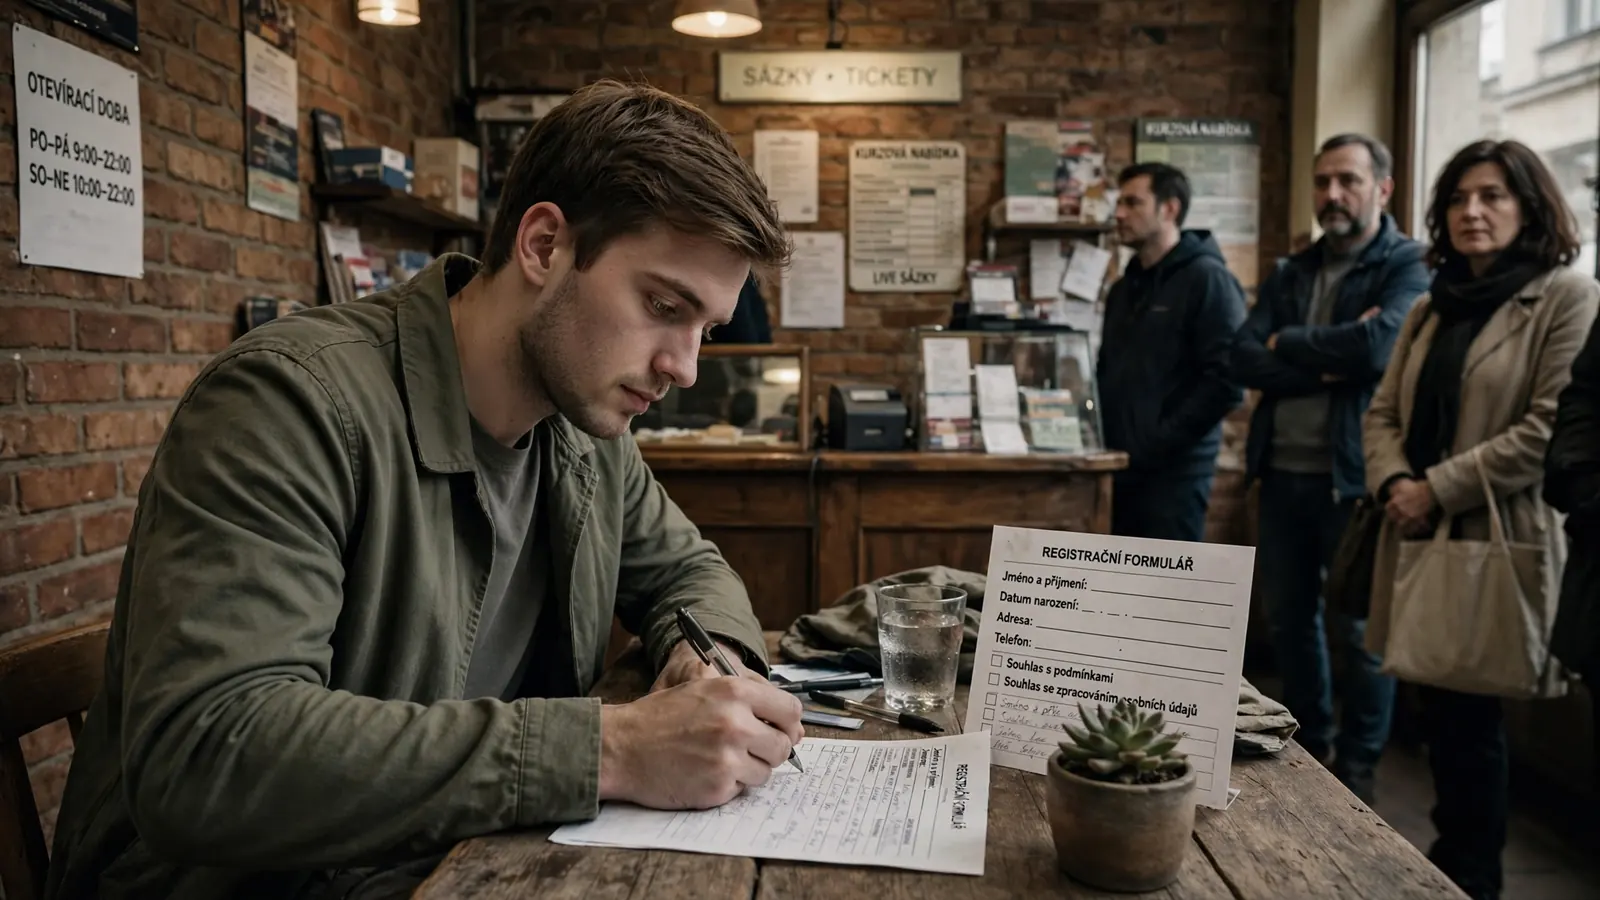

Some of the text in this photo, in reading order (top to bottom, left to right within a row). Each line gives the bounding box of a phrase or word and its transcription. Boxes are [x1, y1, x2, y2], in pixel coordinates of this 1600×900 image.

[742, 64, 938, 87] SÁZKY TICKETY
[28, 71, 130, 125] OTEVÍRACÍ DOBA
[873, 271, 896, 284] LIVE
[1042, 546, 1194, 571] REGISTRAČNÍ FORMULÁŘ
[1002, 571, 1034, 584] Jméno
[1000, 591, 1079, 610] Datum narození:
[996, 612, 1033, 626] Adresa:
[995, 632, 1032, 647] Telefon:
[1006, 658, 1044, 673] Souhlas
[1054, 667, 1114, 683] podmínkami
[1004, 676, 1041, 692] Souhlas
[1043, 684, 1054, 693] se
[1057, 687, 1118, 704] zpracováním
[1169, 702, 1198, 718] údajů
